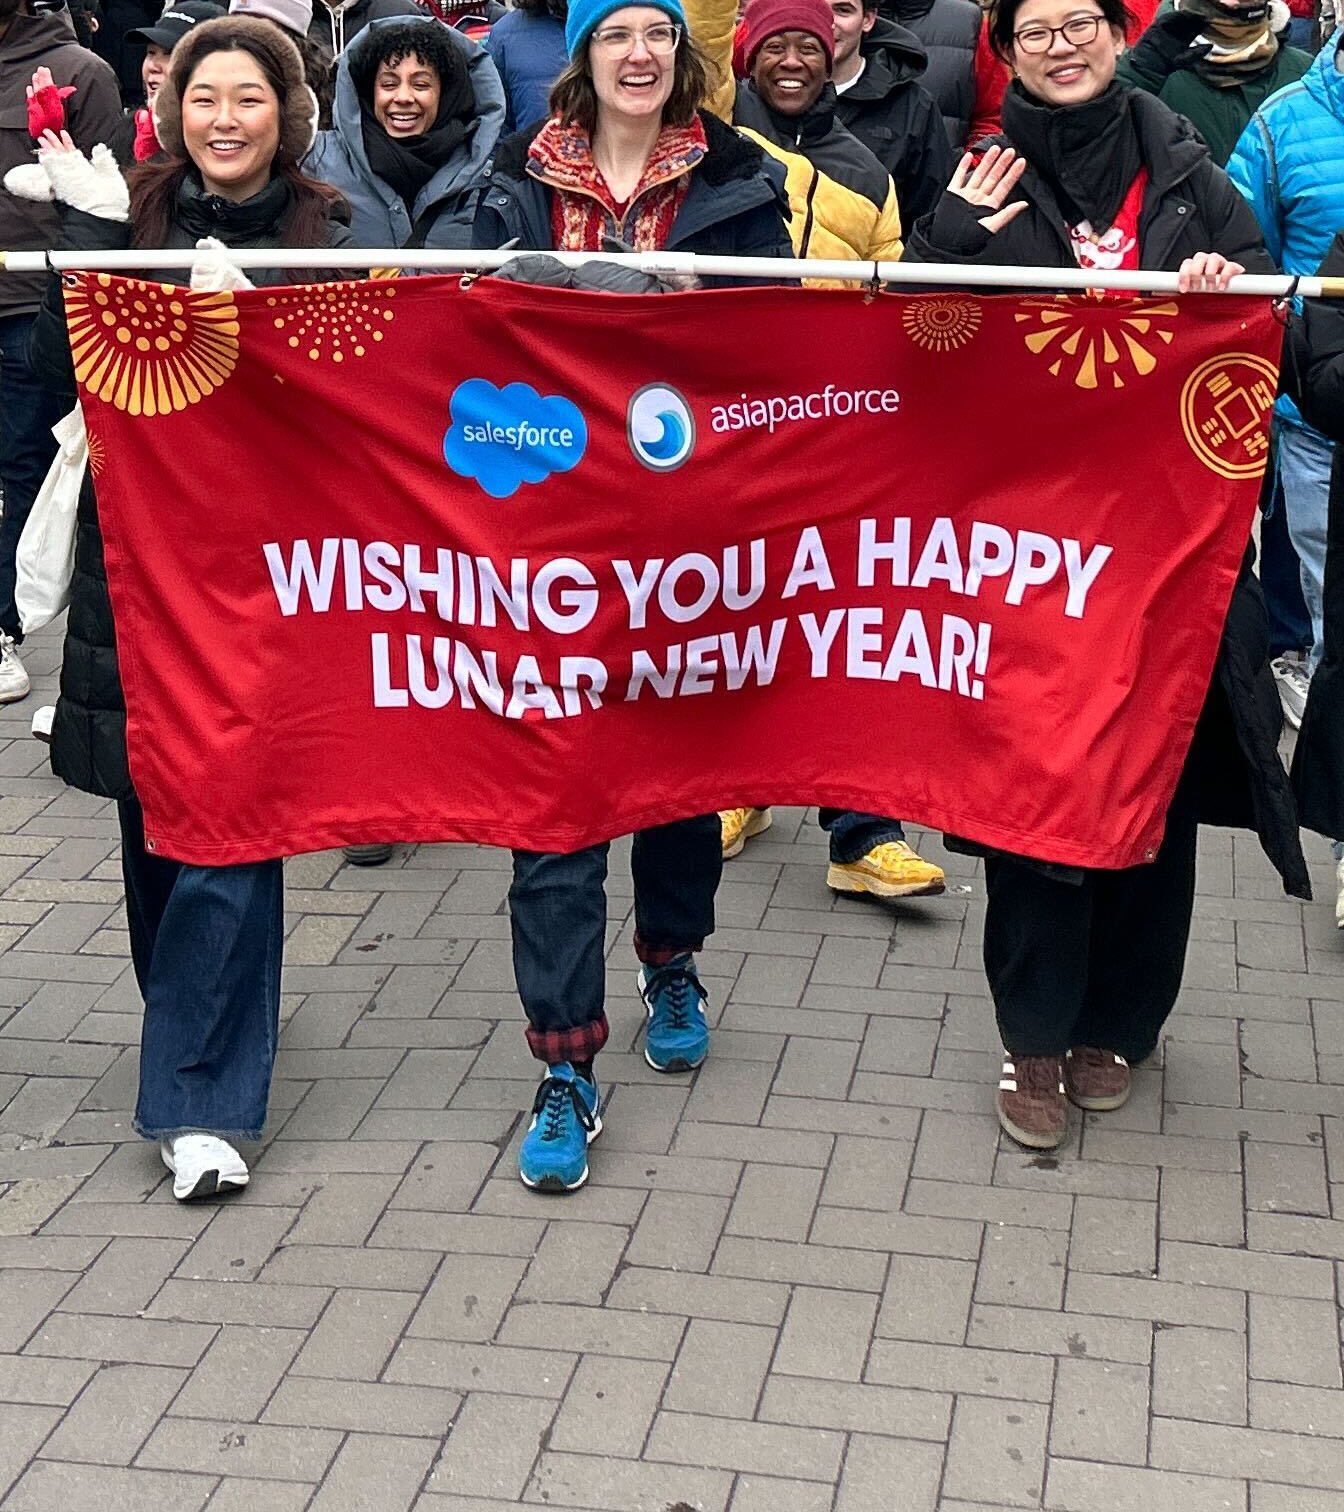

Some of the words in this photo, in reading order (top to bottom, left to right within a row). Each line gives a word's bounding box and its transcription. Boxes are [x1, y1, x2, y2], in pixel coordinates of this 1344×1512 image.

[463, 420, 573, 451] salesforce
[710, 384, 900, 433] asiapacforce
[262, 536, 600, 635] WISHING
[611, 550, 766, 631] YOU
[782, 526, 835, 594] A
[857, 516, 1113, 620] HAPPY
[369, 632, 608, 721] LUNAR
[623, 618, 787, 704] NEW
[799, 606, 992, 700] YEAR!
